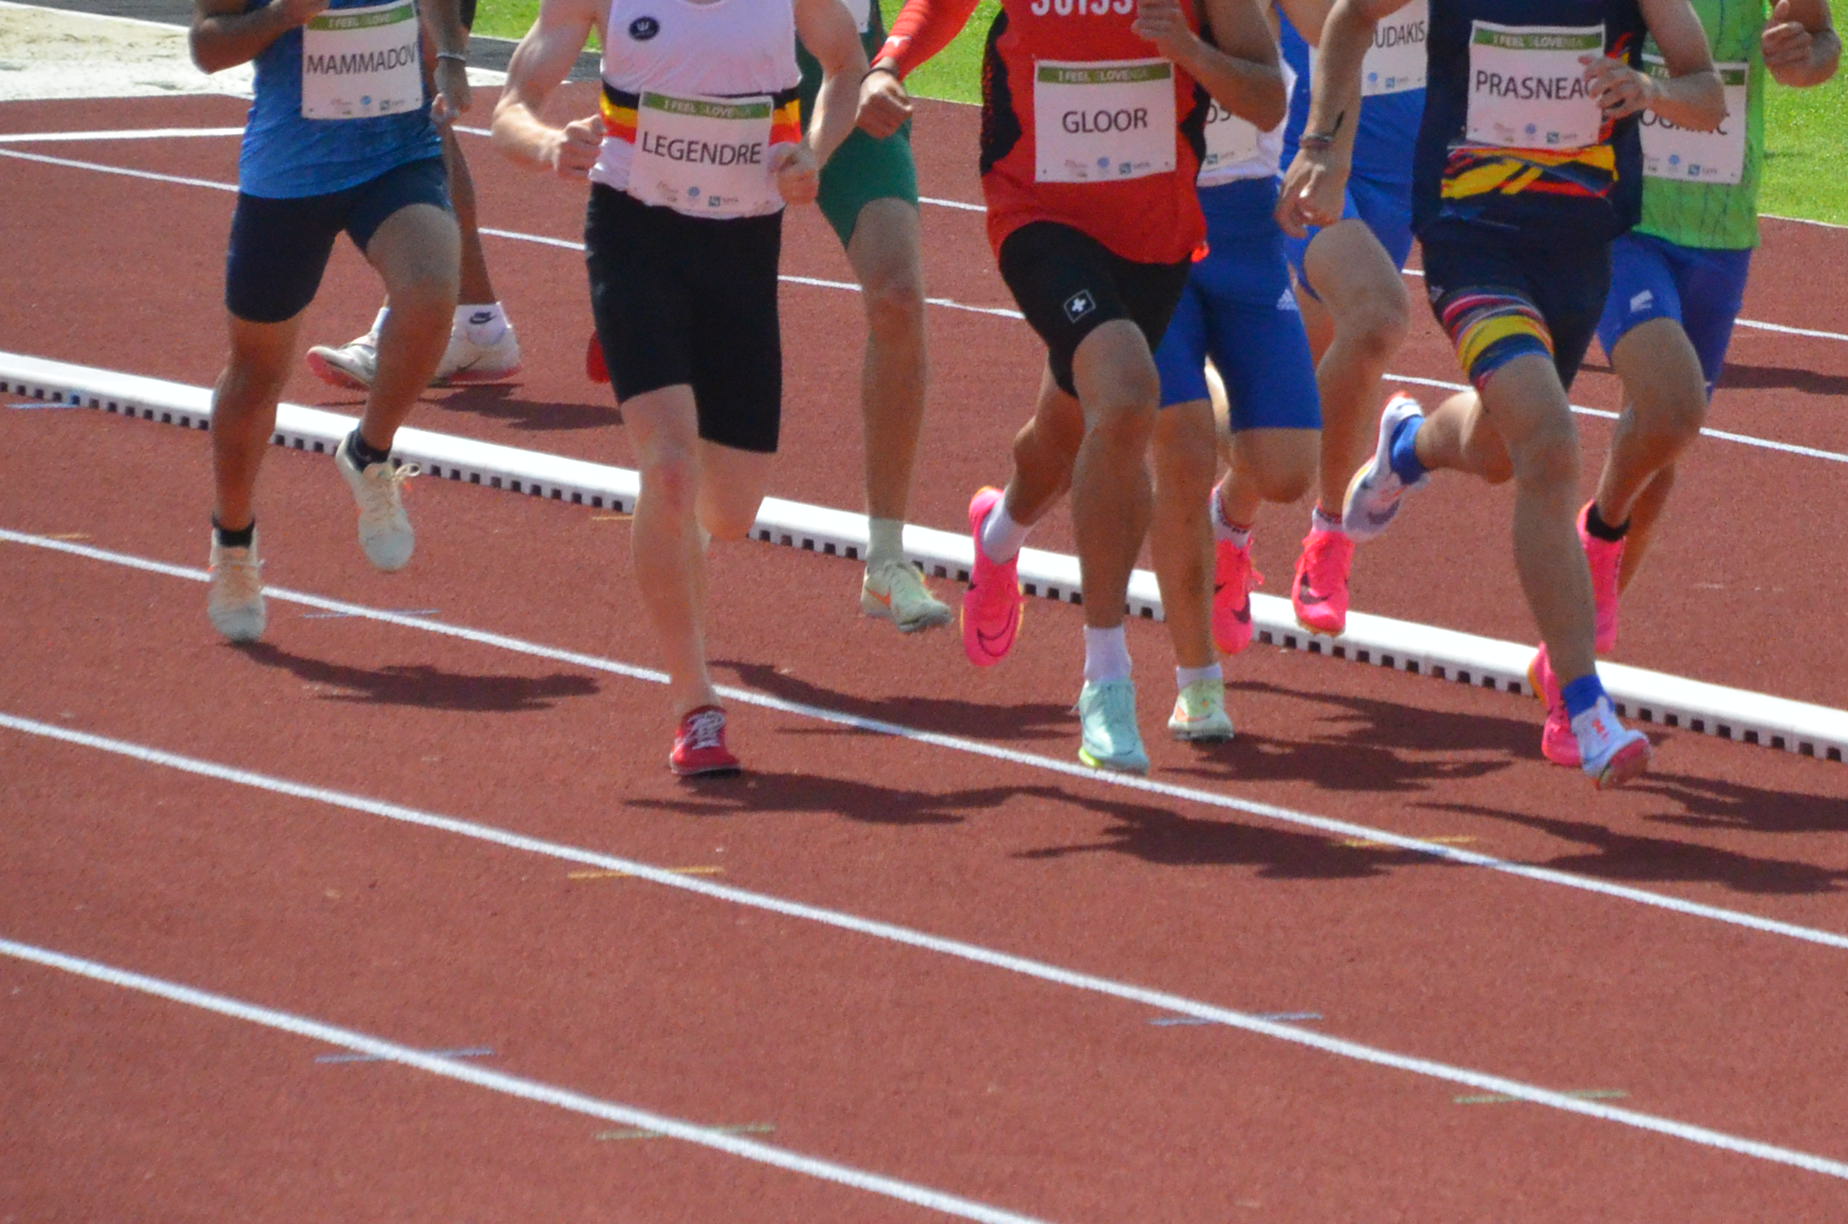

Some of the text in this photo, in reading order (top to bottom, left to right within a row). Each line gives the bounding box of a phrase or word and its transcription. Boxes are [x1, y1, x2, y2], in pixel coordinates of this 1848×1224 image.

[1374, 20, 1425, 48] UDAKIS
[1062, 107, 1148, 134] GLOOR
[642, 131, 762, 166] LEGENDRE
